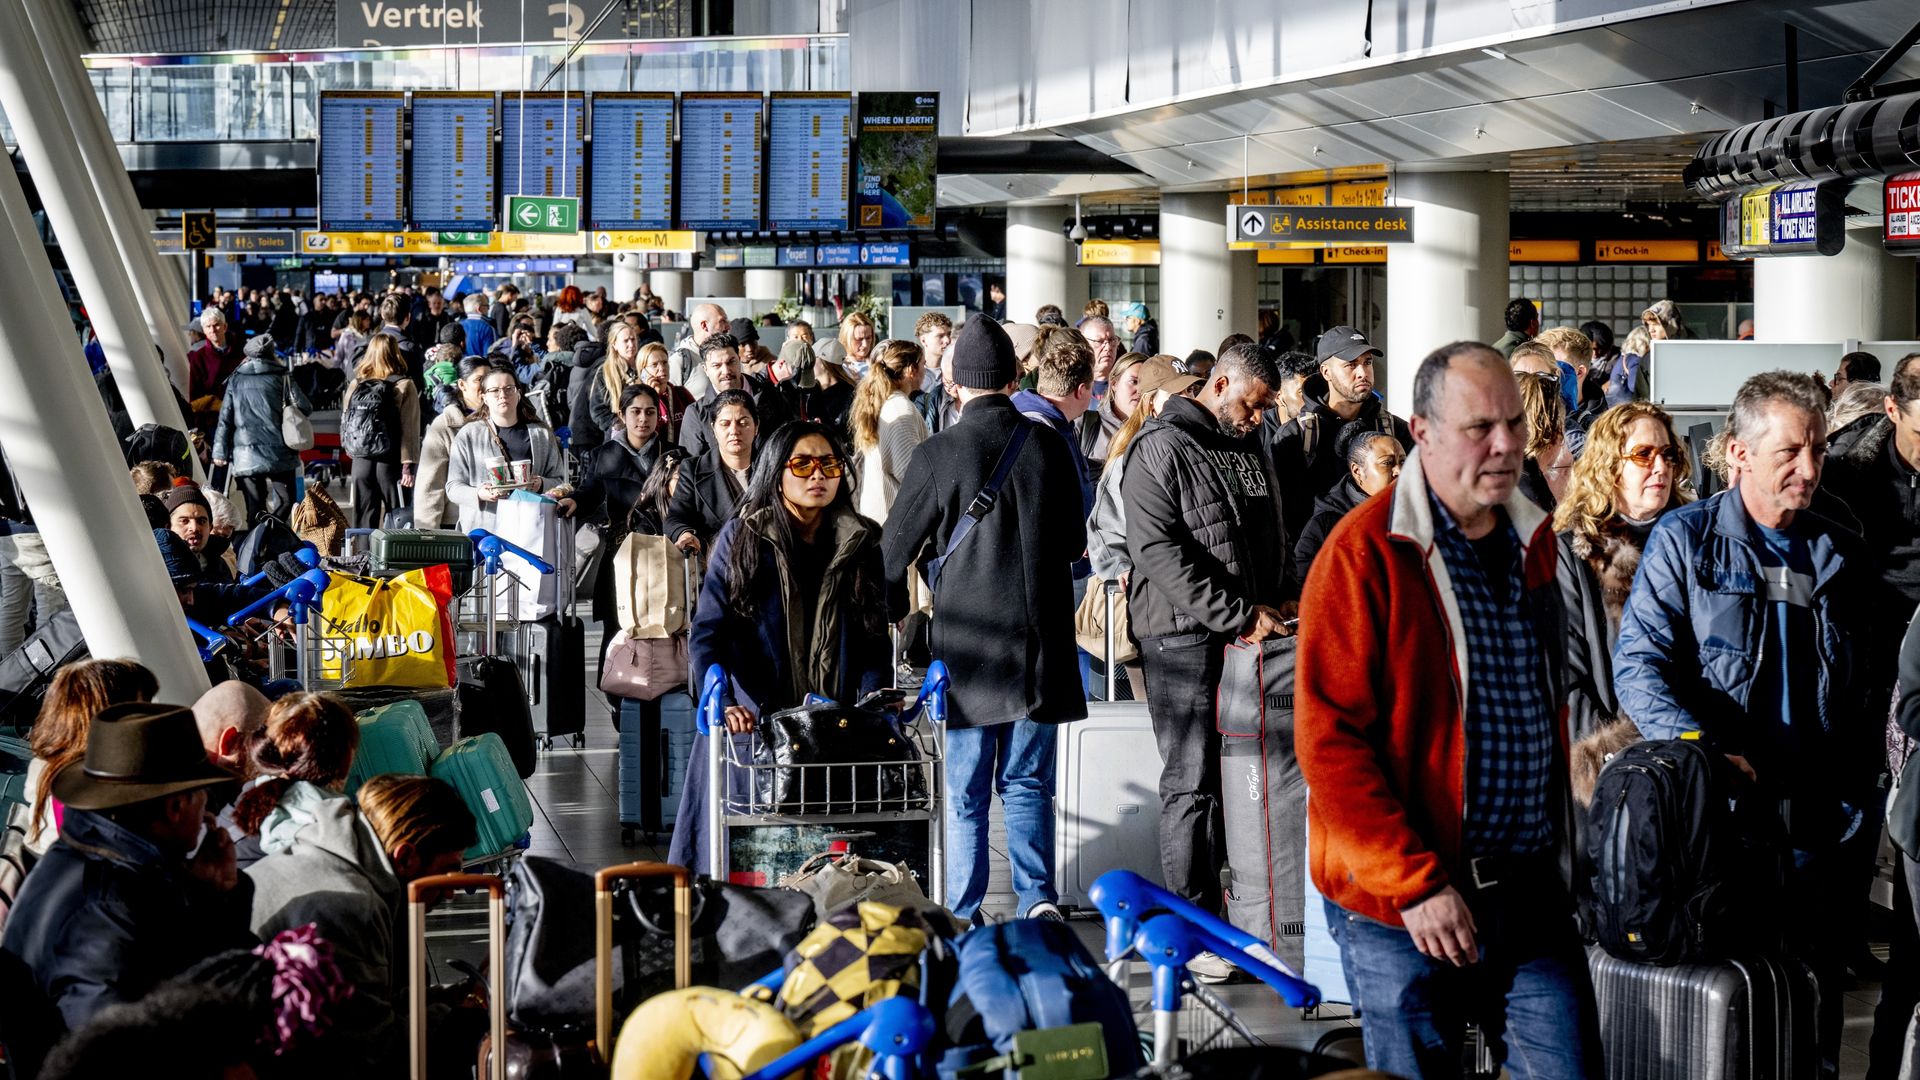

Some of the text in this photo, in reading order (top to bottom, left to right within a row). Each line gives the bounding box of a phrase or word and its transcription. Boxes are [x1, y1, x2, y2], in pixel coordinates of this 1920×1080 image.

[361, 2, 484, 30] Vertrek
[1781, 190, 1816, 213] ALL AIRLINES
[1295, 217, 1407, 231] Assistance desk
[1781, 218, 1798, 239] TICKET
[1799, 216, 1816, 239] SALES
[257, 237, 285, 246] Toilets
[357, 237, 381, 246] Trains
[628, 234, 668, 247] Gates M
[884, 245, 899, 253] Tickets
[1097, 248, 1129, 258] Check-in
[1342, 247, 1383, 257] Check-in
[1613, 246, 1648, 256] Check-in
